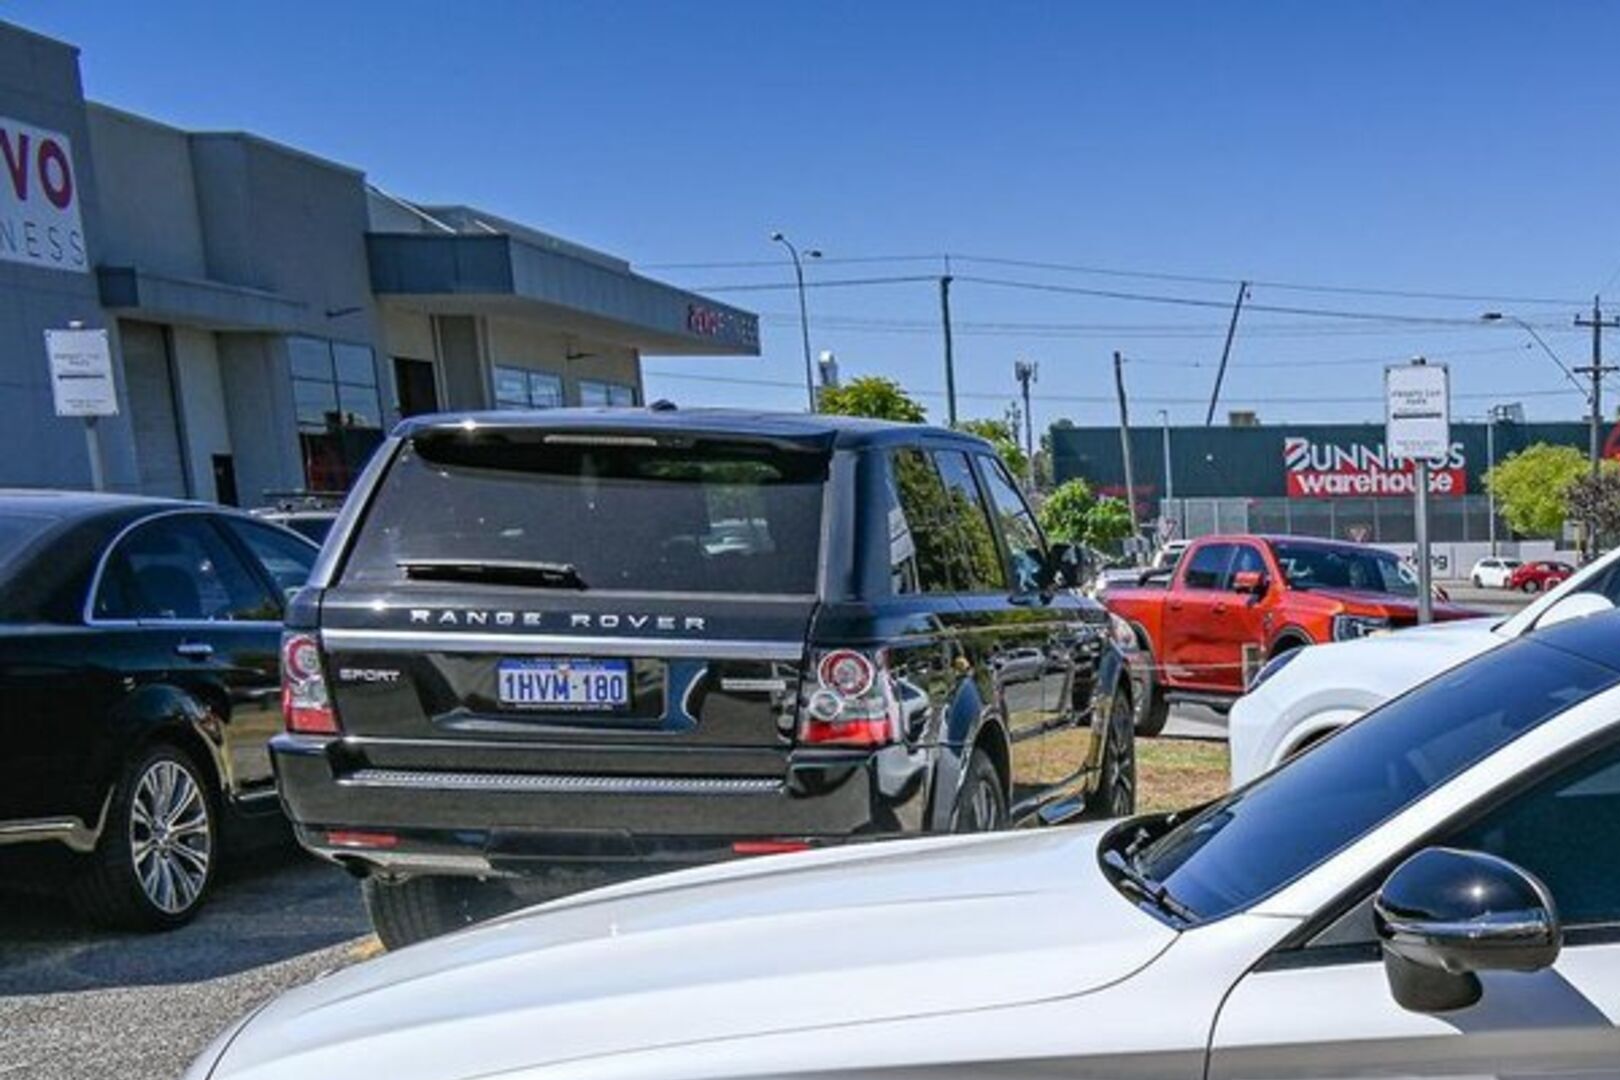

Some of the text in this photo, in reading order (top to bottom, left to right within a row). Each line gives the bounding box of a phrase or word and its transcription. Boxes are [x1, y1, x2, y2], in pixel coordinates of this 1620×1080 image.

[0, 216, 85, 266] NESS
[410, 609, 705, 631] RANGE ROVER
[339, 668, 401, 682] SPORT
